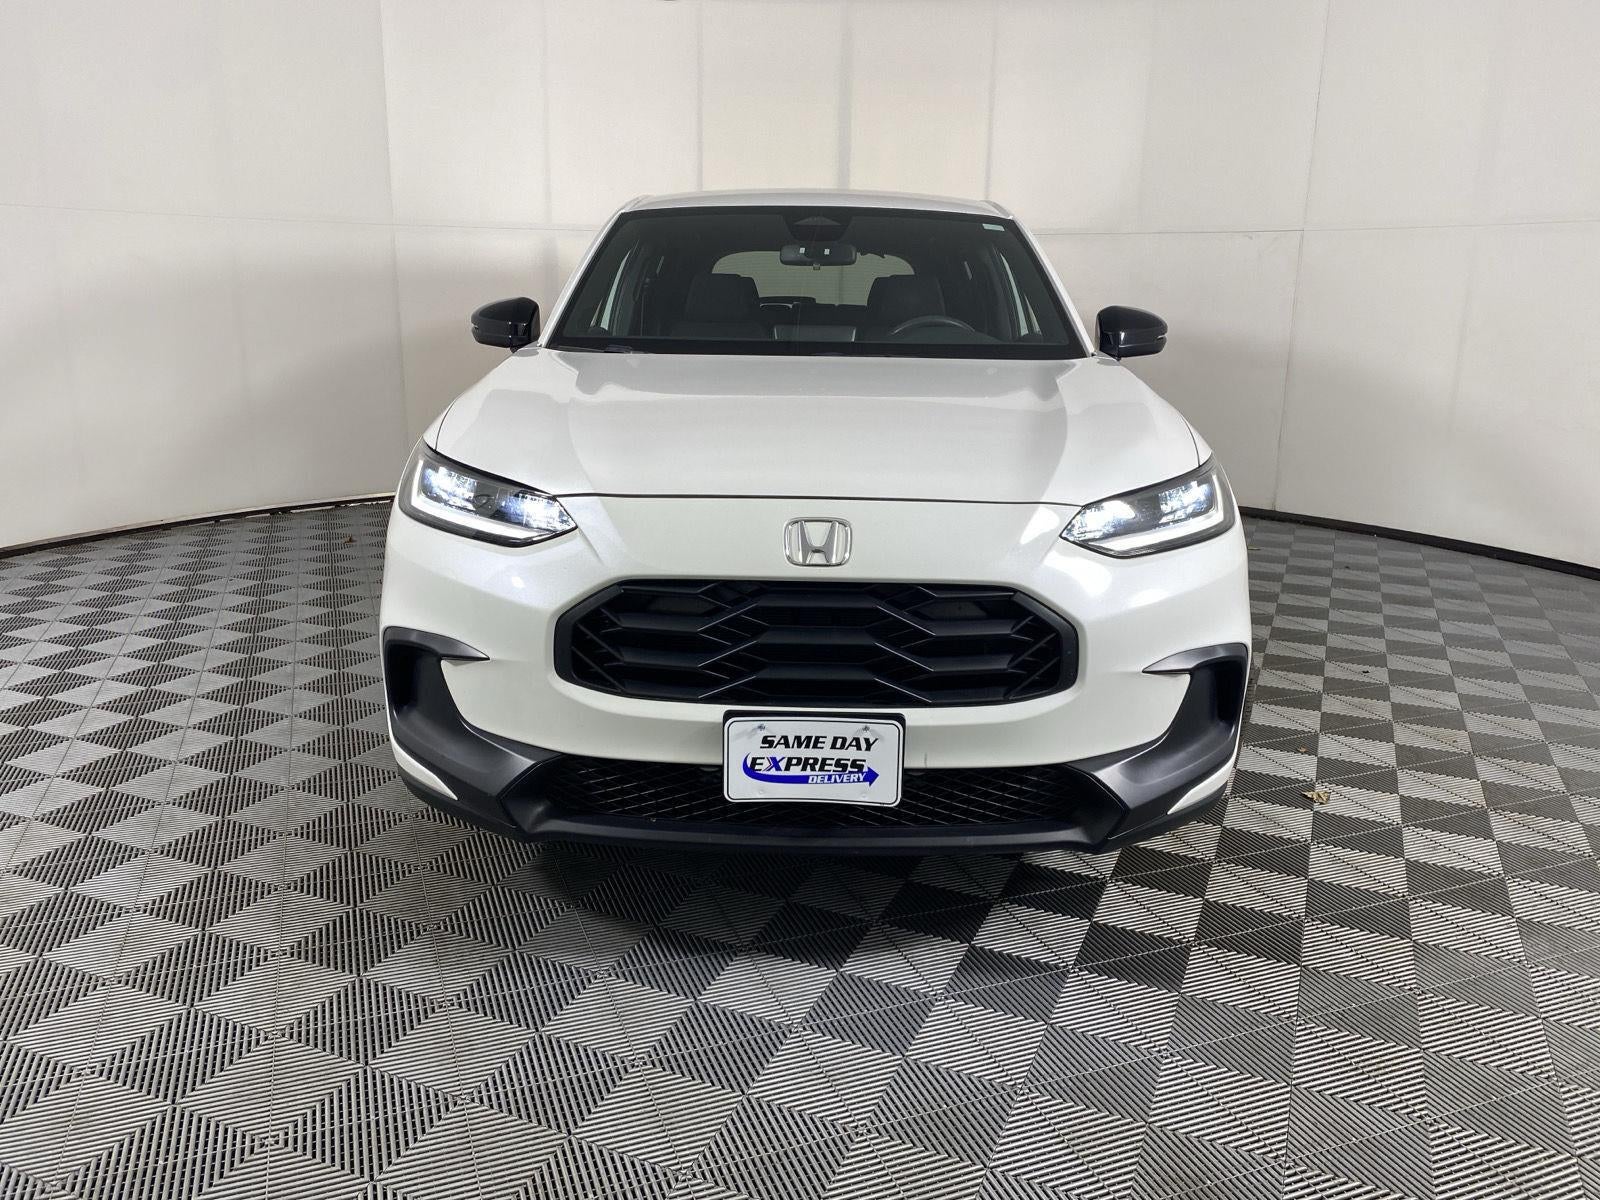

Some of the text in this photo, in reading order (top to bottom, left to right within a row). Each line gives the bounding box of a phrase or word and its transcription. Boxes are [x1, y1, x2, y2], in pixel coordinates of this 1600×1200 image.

[760, 735, 879, 751] SAME DAY
[750, 756, 867, 773] EXPRESS
[808, 772, 866, 784] DELIVERY
